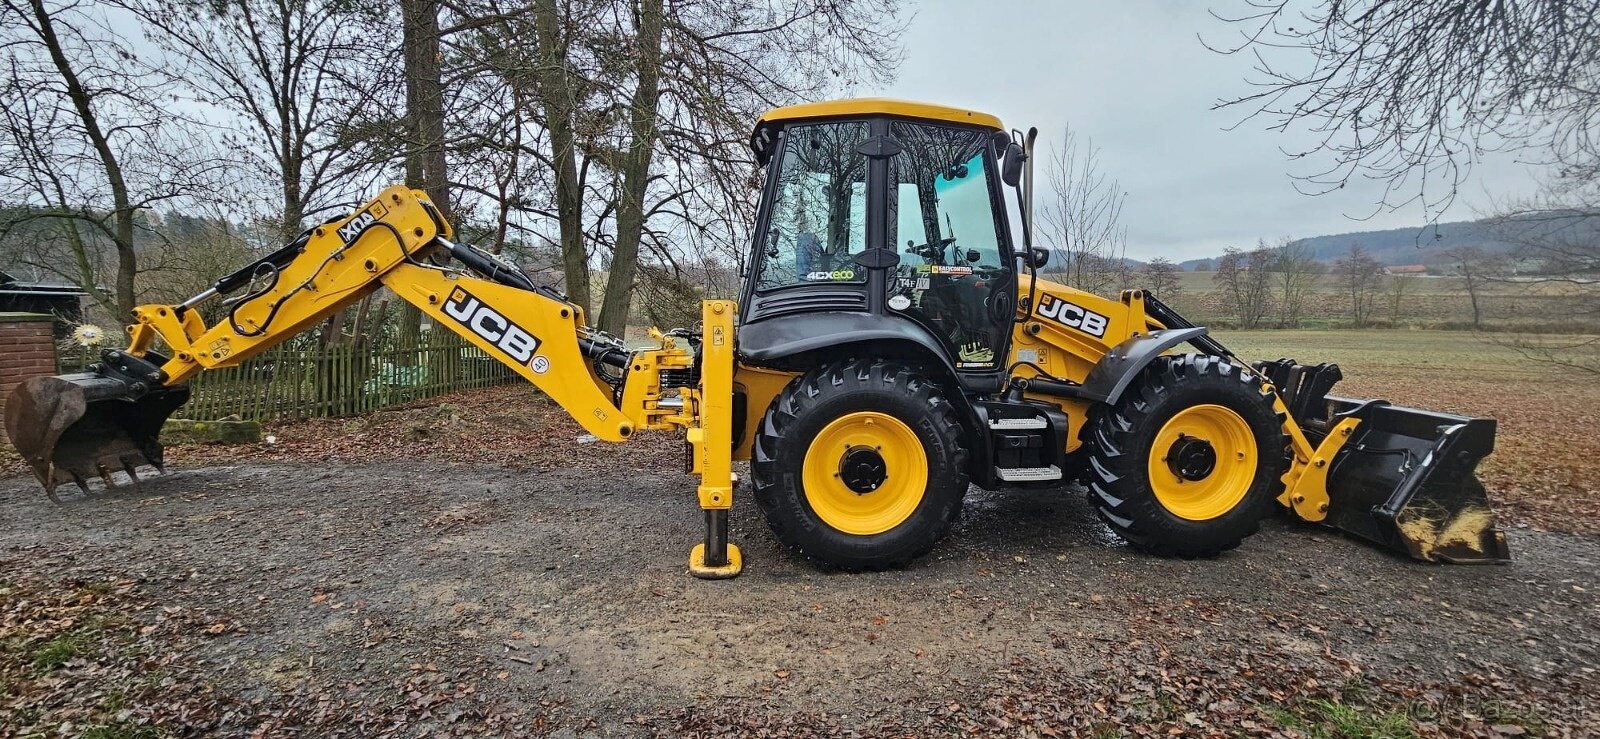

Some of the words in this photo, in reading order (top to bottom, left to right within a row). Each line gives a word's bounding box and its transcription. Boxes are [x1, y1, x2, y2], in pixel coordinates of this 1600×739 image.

[806, 270, 854, 280] 4CXeco
[445, 298, 536, 362] JCB
[1038, 299, 1107, 336] JCB
[534, 358, 547, 371] 40
